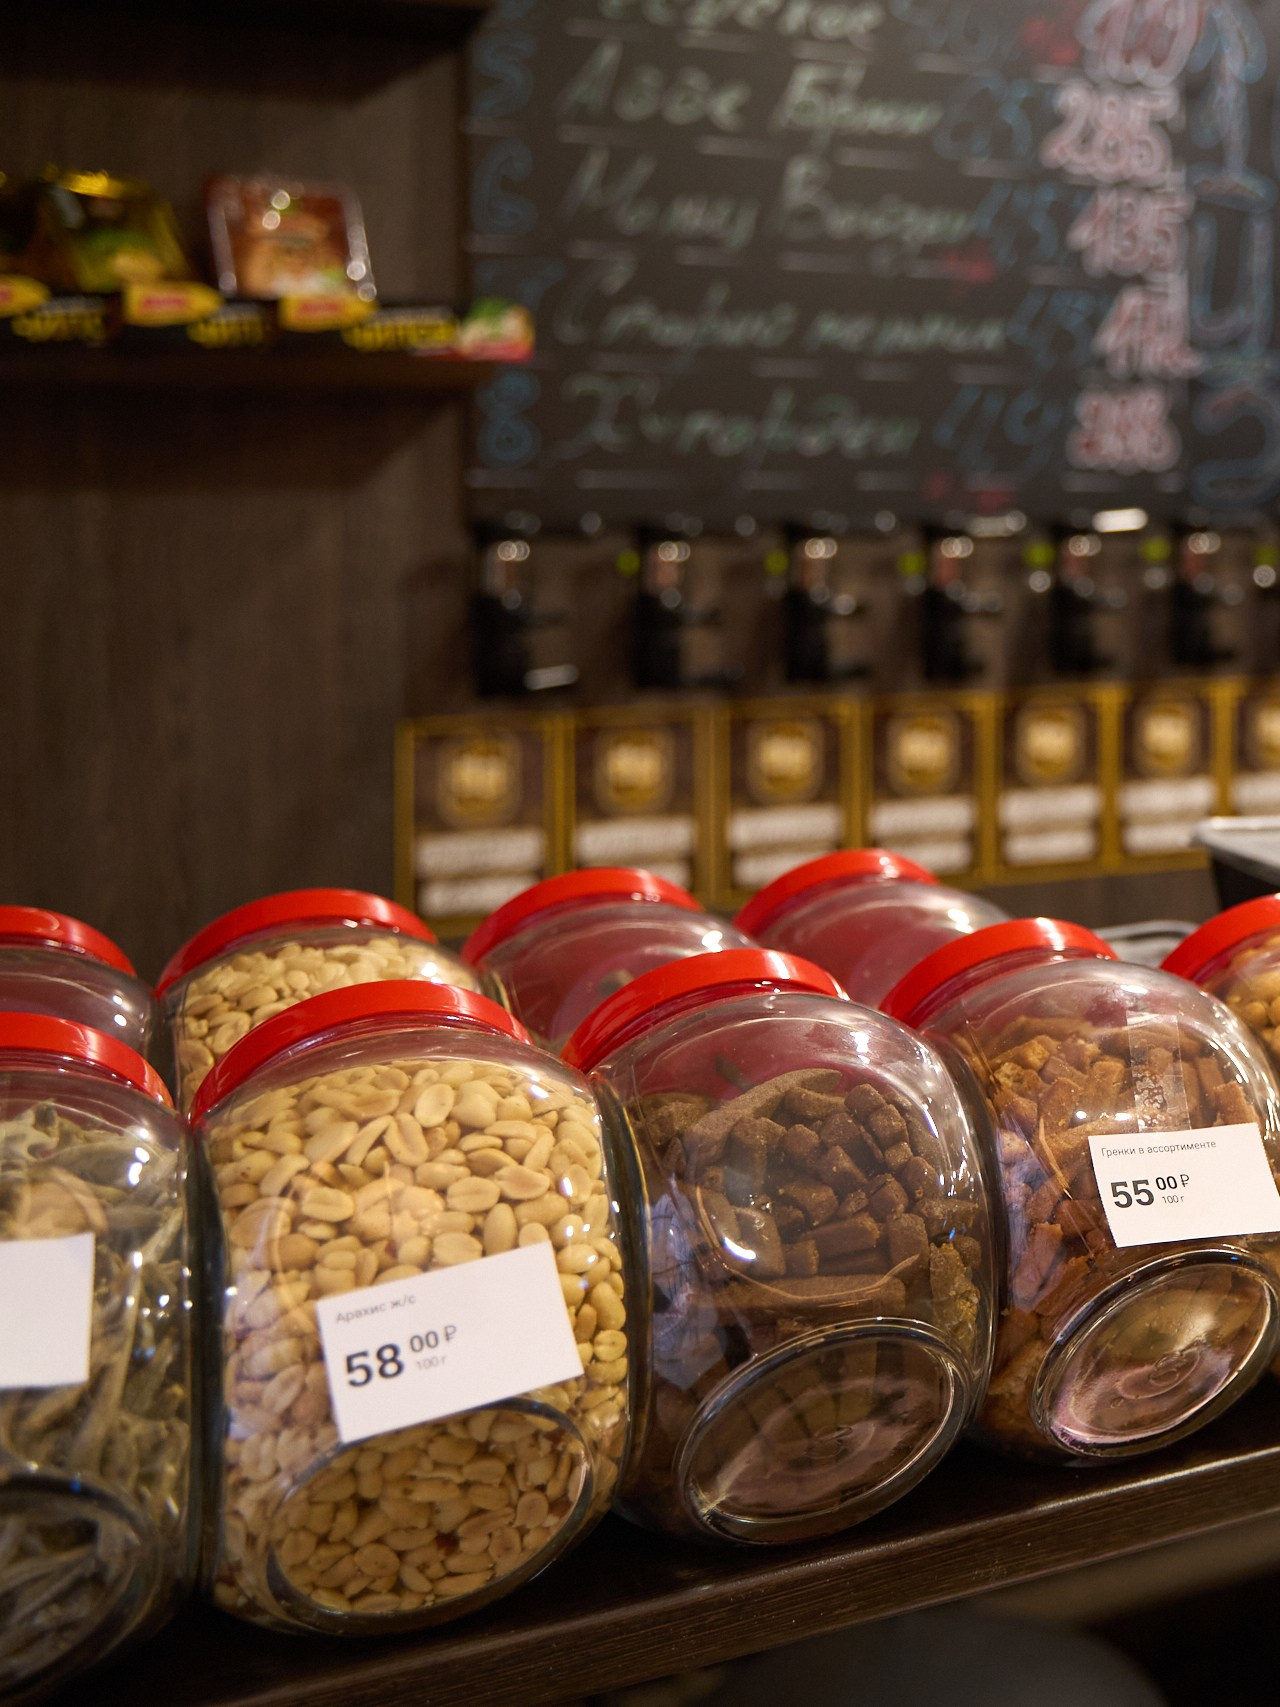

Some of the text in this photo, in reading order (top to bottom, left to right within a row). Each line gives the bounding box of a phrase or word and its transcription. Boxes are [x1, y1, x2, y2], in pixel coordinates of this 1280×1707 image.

[1101, 1140, 1217, 1158] Гренки в ассортименте
[1110, 1179, 1155, 1209] 55
[1161, 1194, 1179, 1205] 100
[336, 1293, 417, 1324] Арахис ж/с
[345, 1343, 405, 1388] 58
[416, 1356, 439, 1372] 100
